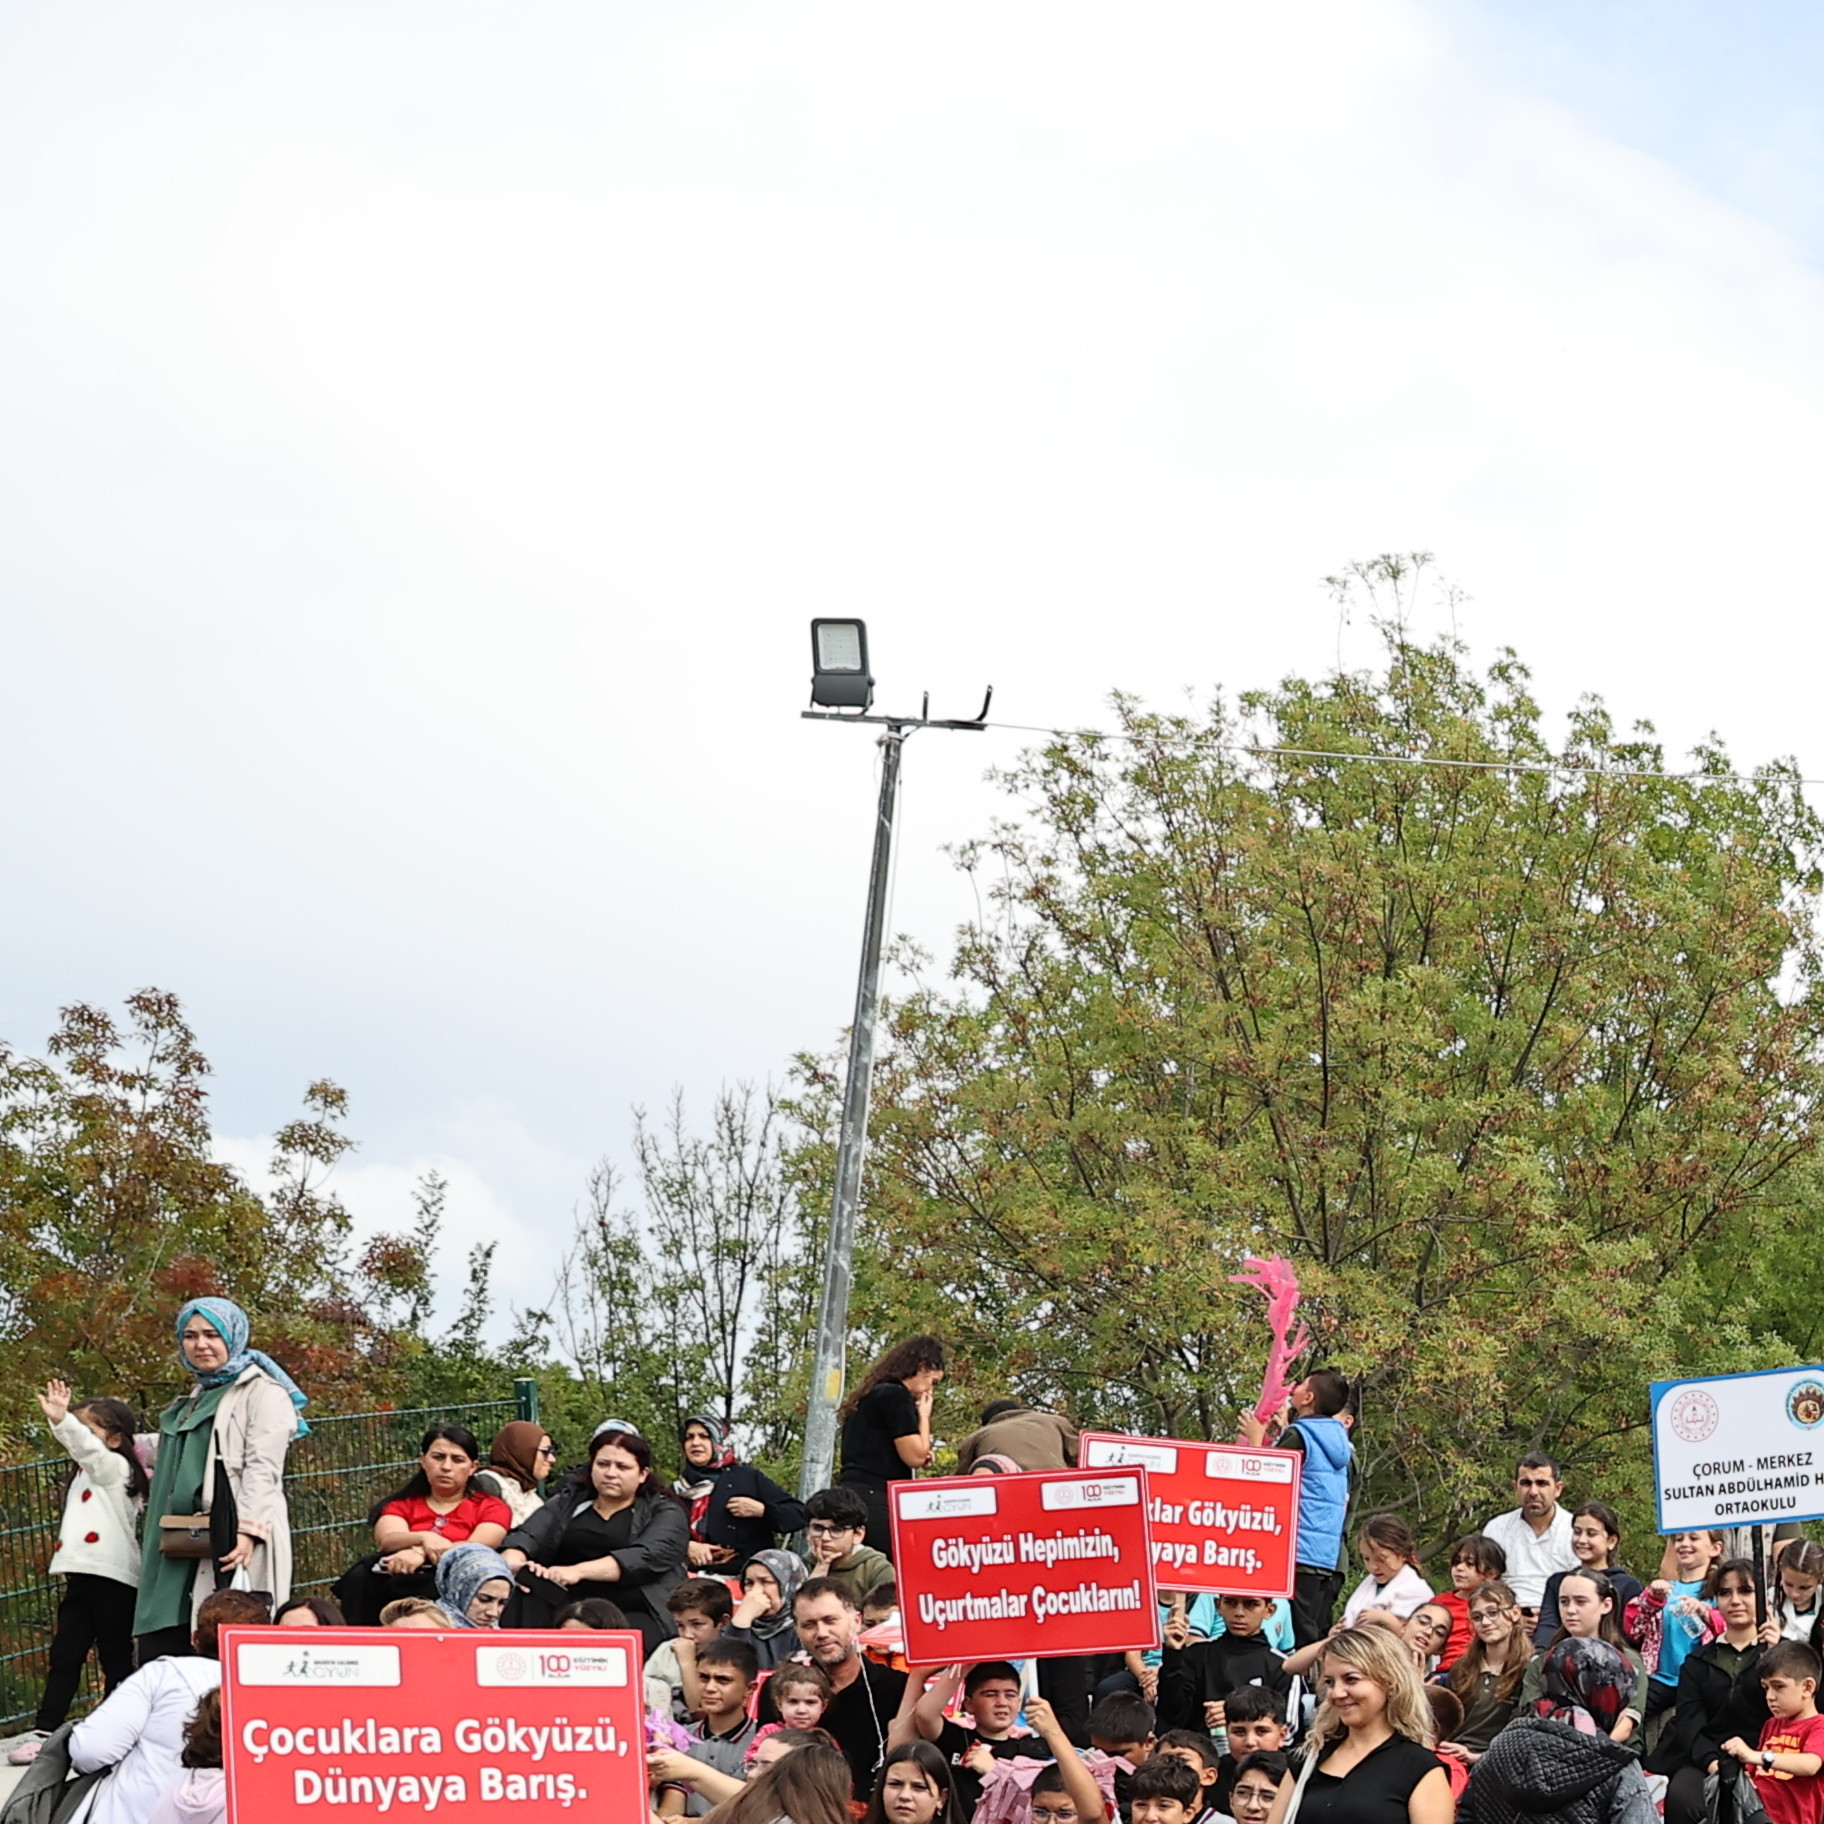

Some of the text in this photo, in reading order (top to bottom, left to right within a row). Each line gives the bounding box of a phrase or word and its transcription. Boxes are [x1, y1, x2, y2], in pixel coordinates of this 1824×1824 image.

[1693, 1460, 1745, 1480] ÇORUM
[1757, 1452, 1813, 1470] MERKEZ
[1664, 1484, 1715, 1501] SULTAN
[1718, 1474, 1810, 1496] ABDÜLHAMİD
[1188, 1500, 1283, 1536] Gökyüzü,
[1714, 1496, 1797, 1516] ORTAOKULU
[932, 1528, 1119, 1574] Gökyüzü Hepimizin,
[1203, 1546, 1263, 1575] Barış.
[919, 1579, 1141, 1631] Uçurtmalar Çocukların!
[242, 1717, 628, 1763] Çocuklara Gökyüzü,
[294, 1767, 588, 1811] Dünyaya Barış.
